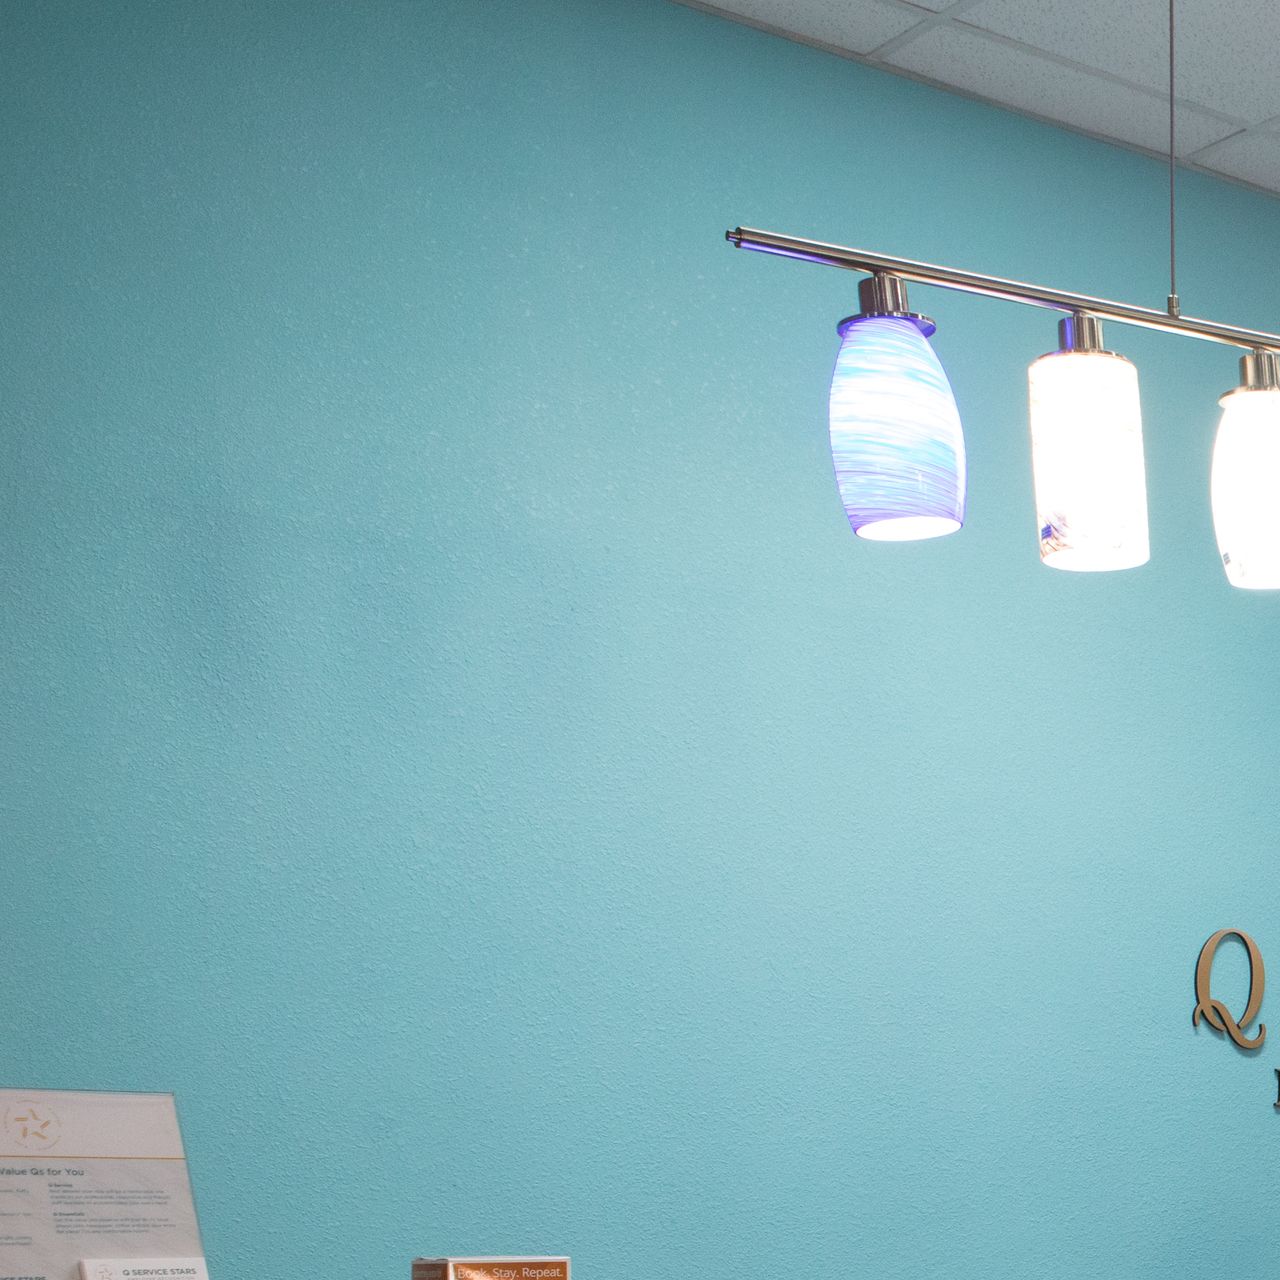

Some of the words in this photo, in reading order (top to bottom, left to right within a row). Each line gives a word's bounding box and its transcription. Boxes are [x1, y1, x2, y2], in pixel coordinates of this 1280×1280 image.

[47, 1167, 62, 1176] for
[65, 1168, 85, 1177] You
[492, 1267, 519, 1280] Stay.
[522, 1267, 564, 1280] Repeat.
